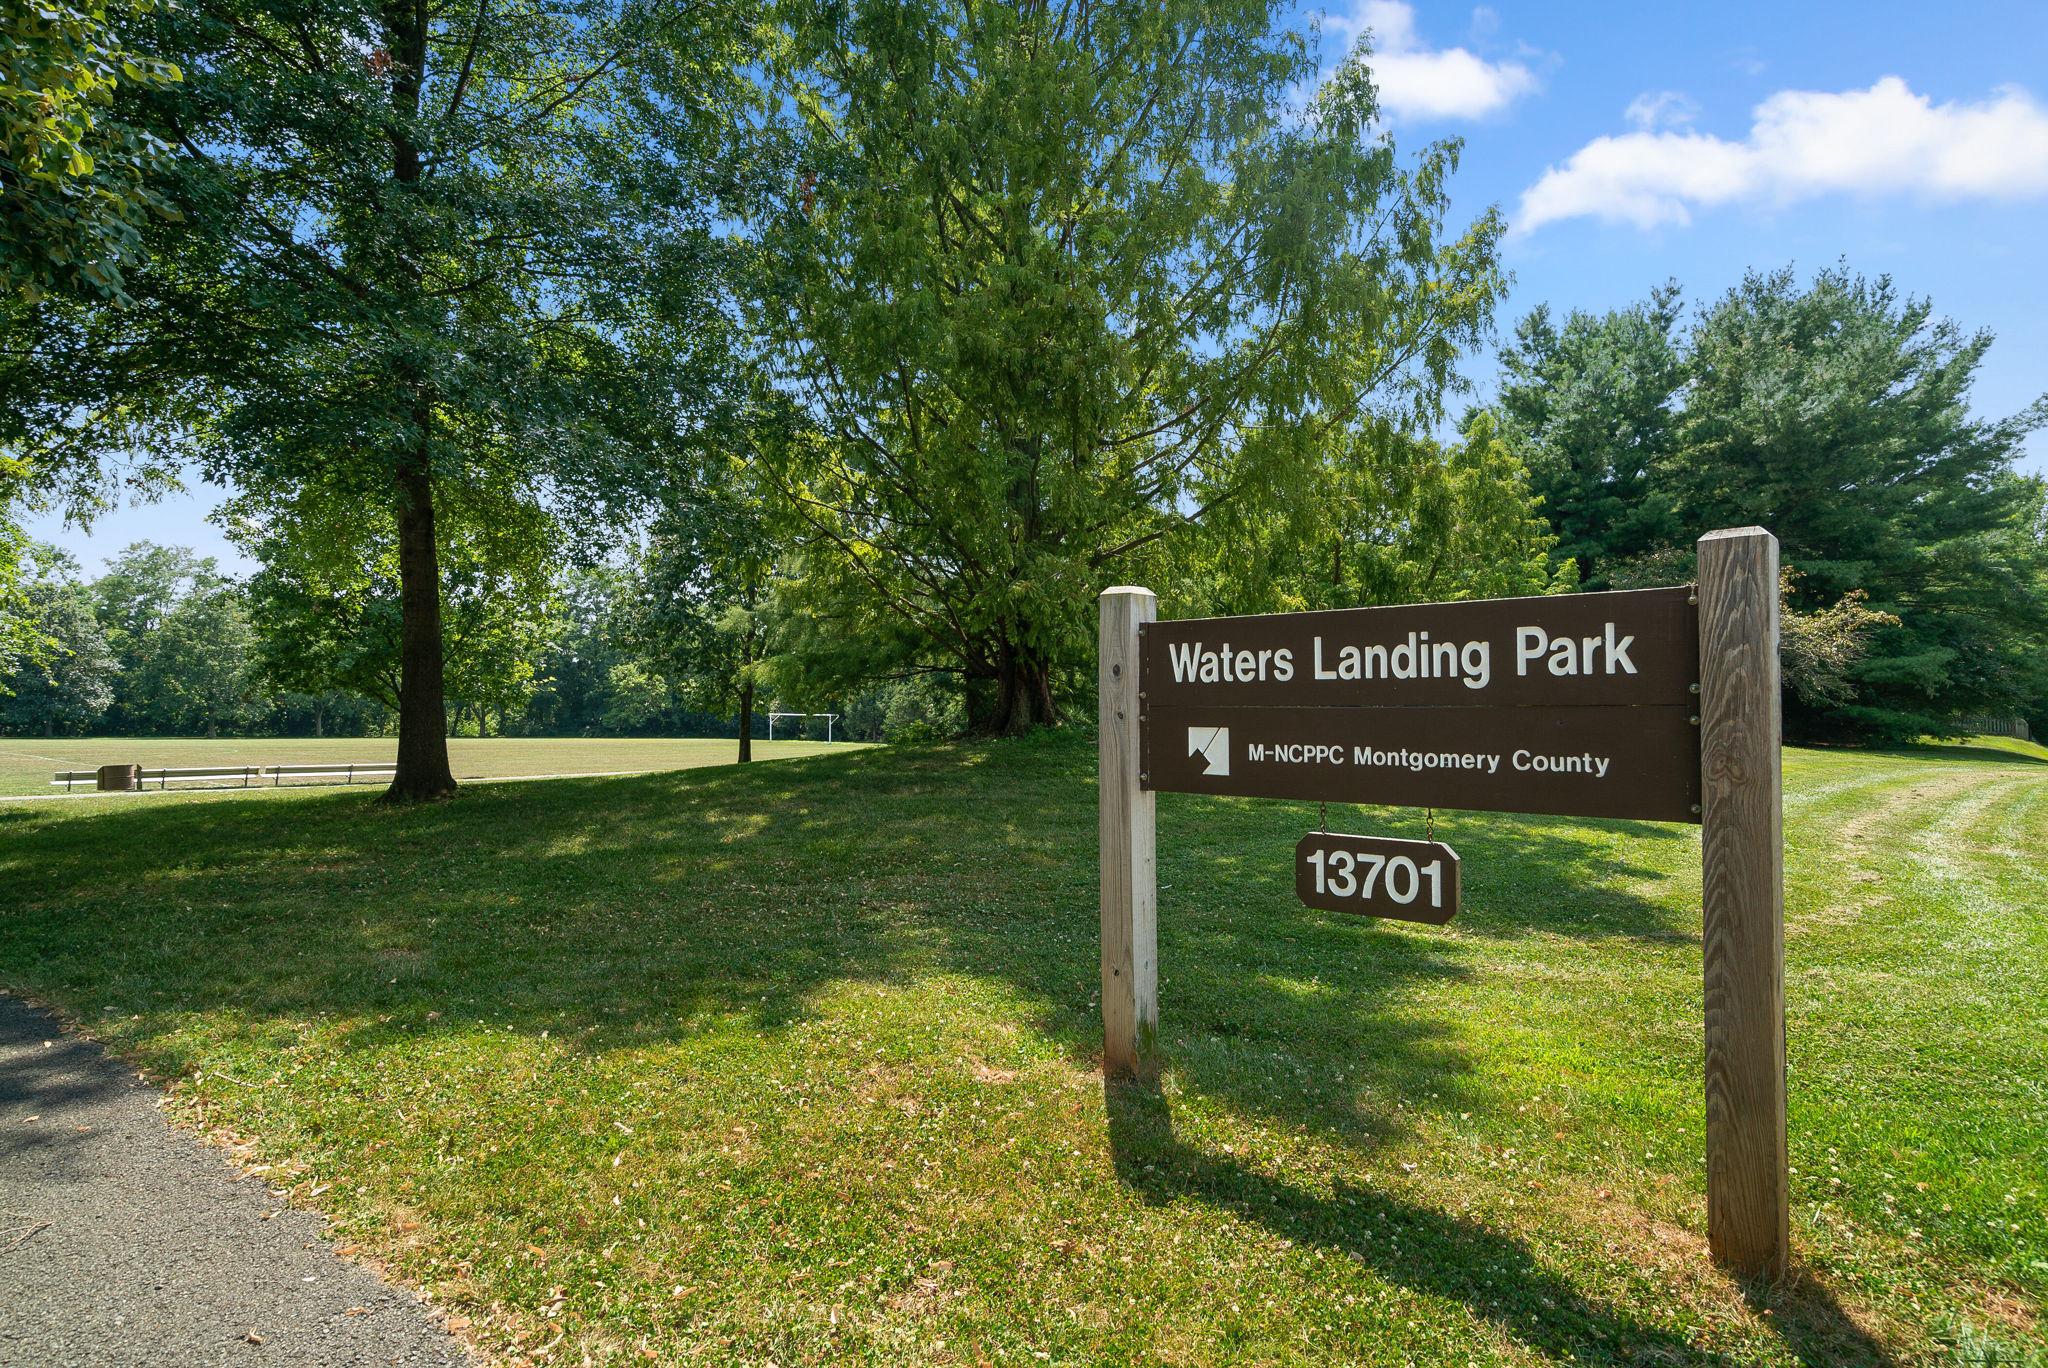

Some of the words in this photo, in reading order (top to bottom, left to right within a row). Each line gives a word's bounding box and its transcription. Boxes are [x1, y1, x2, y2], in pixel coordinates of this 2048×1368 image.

[1168, 641, 1294, 684] Waters
[1313, 631, 1490, 690] Landing
[1516, 622, 1638, 677] Park
[1248, 743, 1345, 765] M-NCPPC
[1353, 746, 1501, 775] Montgomery
[1512, 749, 1611, 779] County
[1306, 848, 1443, 908] 13701
